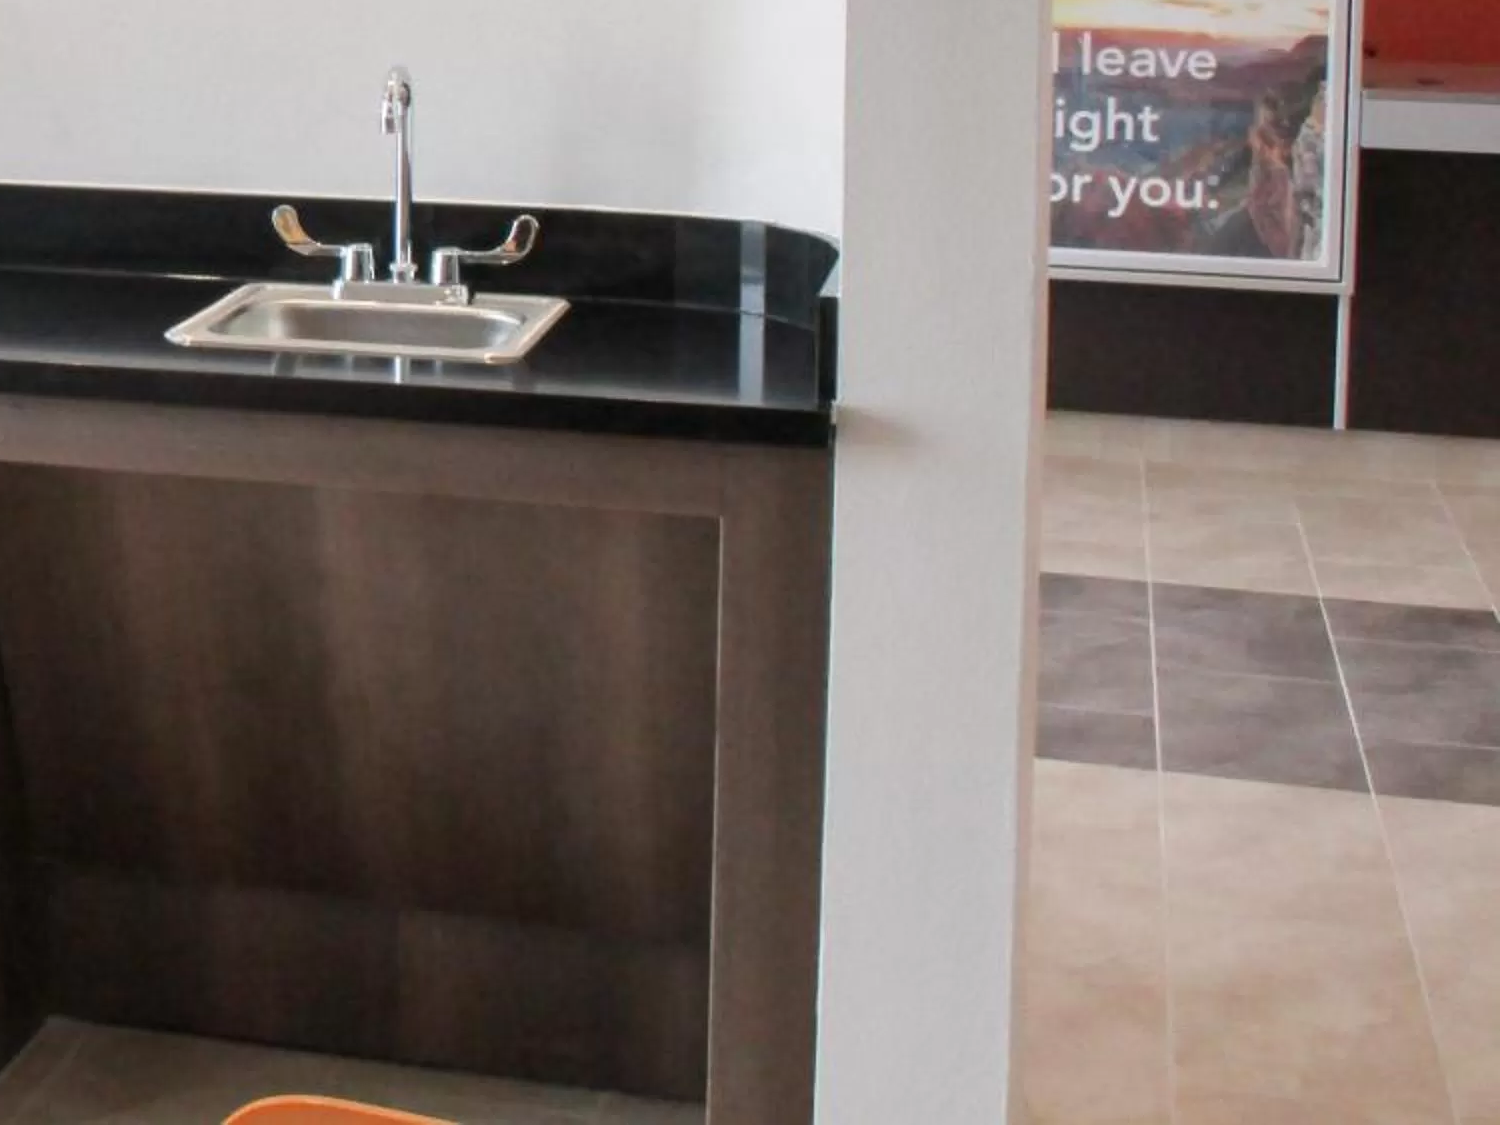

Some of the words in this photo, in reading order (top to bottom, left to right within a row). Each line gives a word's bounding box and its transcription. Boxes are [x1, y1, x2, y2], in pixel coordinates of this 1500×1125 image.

[1080, 31, 1218, 81] leave
[1054, 96, 1160, 152] ight
[1049, 173, 1093, 203] or
